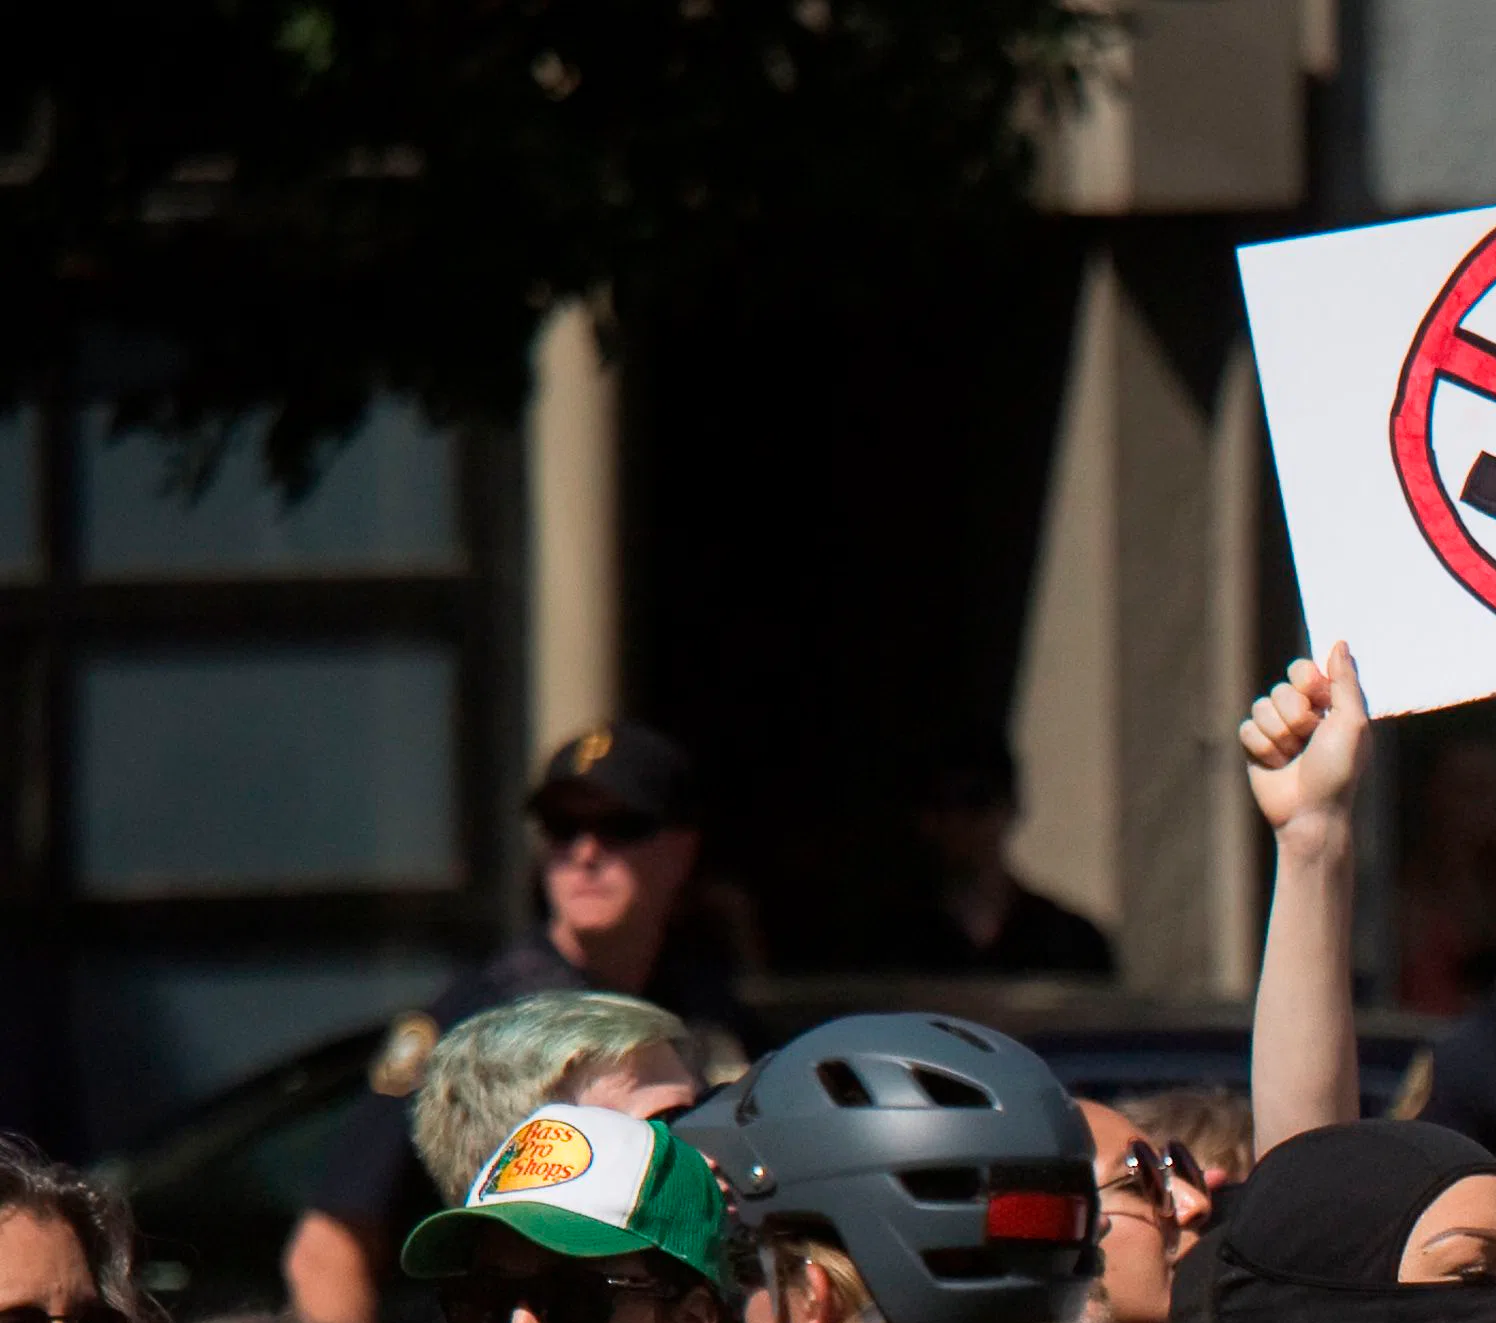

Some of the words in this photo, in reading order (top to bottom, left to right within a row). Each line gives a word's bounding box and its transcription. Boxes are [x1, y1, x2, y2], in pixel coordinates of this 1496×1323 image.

[516, 1121, 575, 1143] Bass
[518, 1140, 554, 1159] Pro
[513, 1158, 575, 1182] Shops
